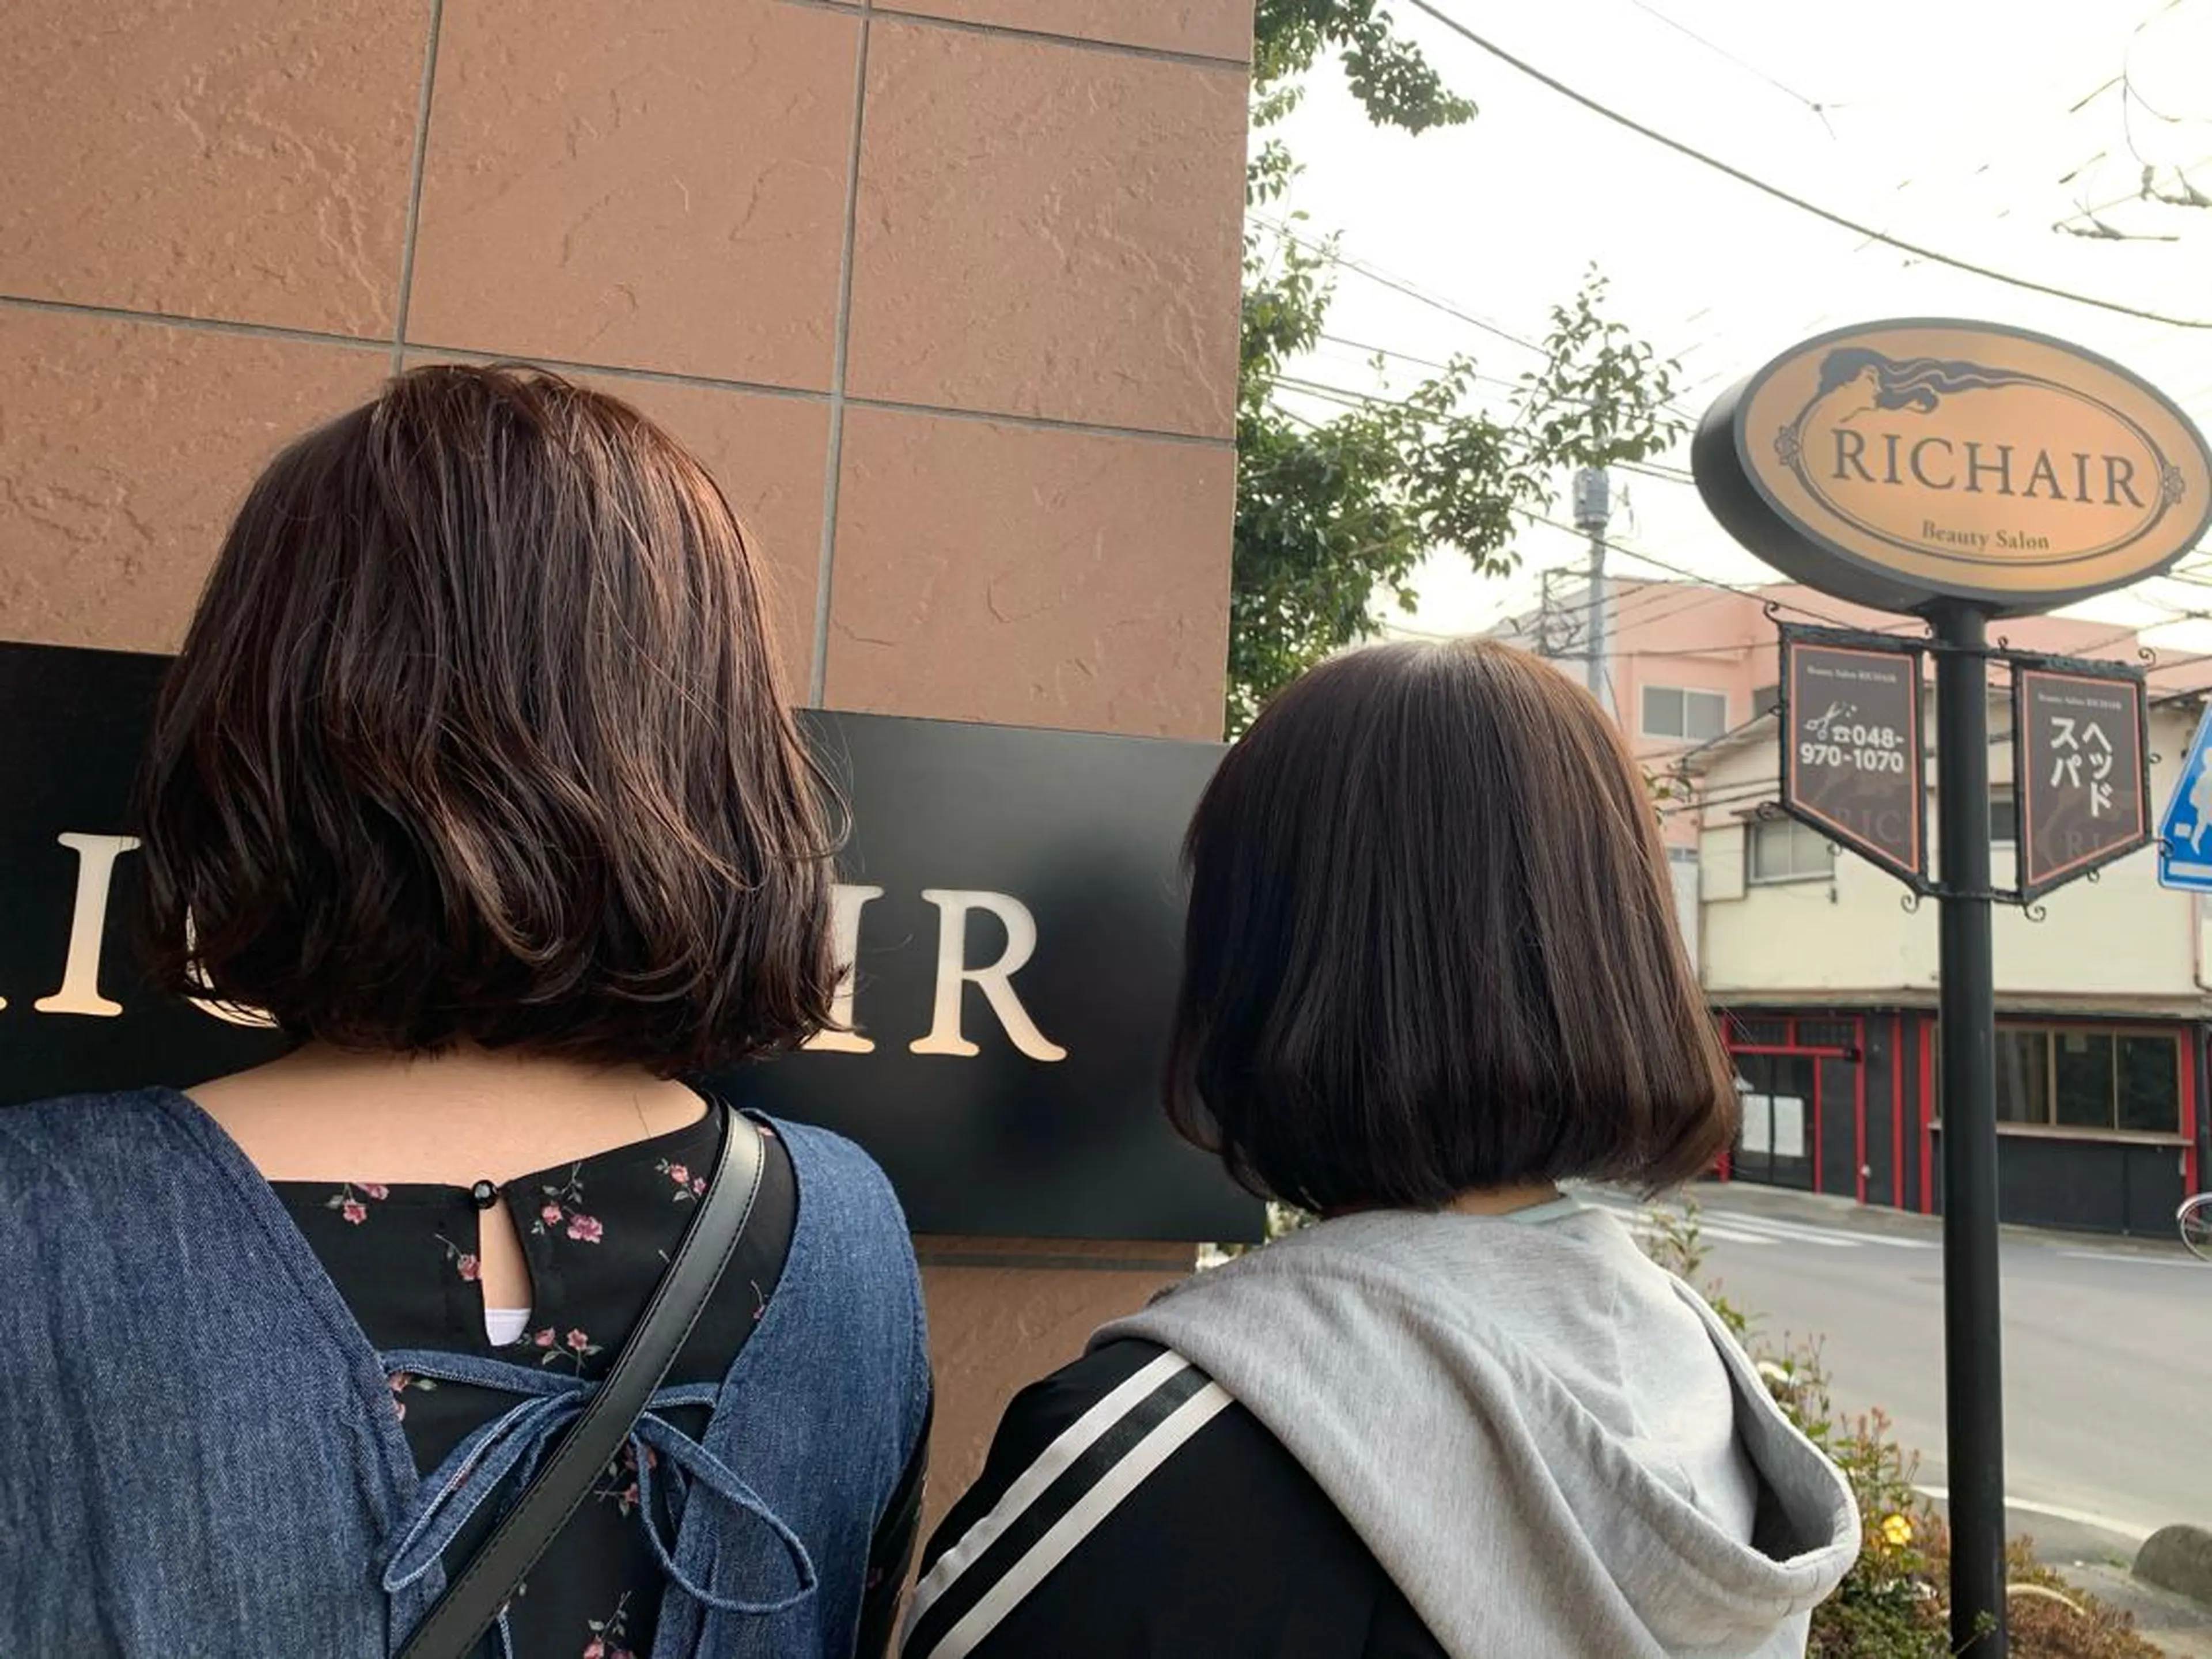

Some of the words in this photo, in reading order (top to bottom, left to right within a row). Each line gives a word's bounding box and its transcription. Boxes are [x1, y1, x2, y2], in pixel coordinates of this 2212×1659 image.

[1830, 427, 2146, 509] RICHAIR
[1922, 519, 1990, 552] Beauty
[1995, 529, 2050, 550] Salon
[1800, 743, 1904, 774] 970-1070
[2050, 716, 2082, 789] スパ
[2081, 722, 2113, 817] ヘッド
